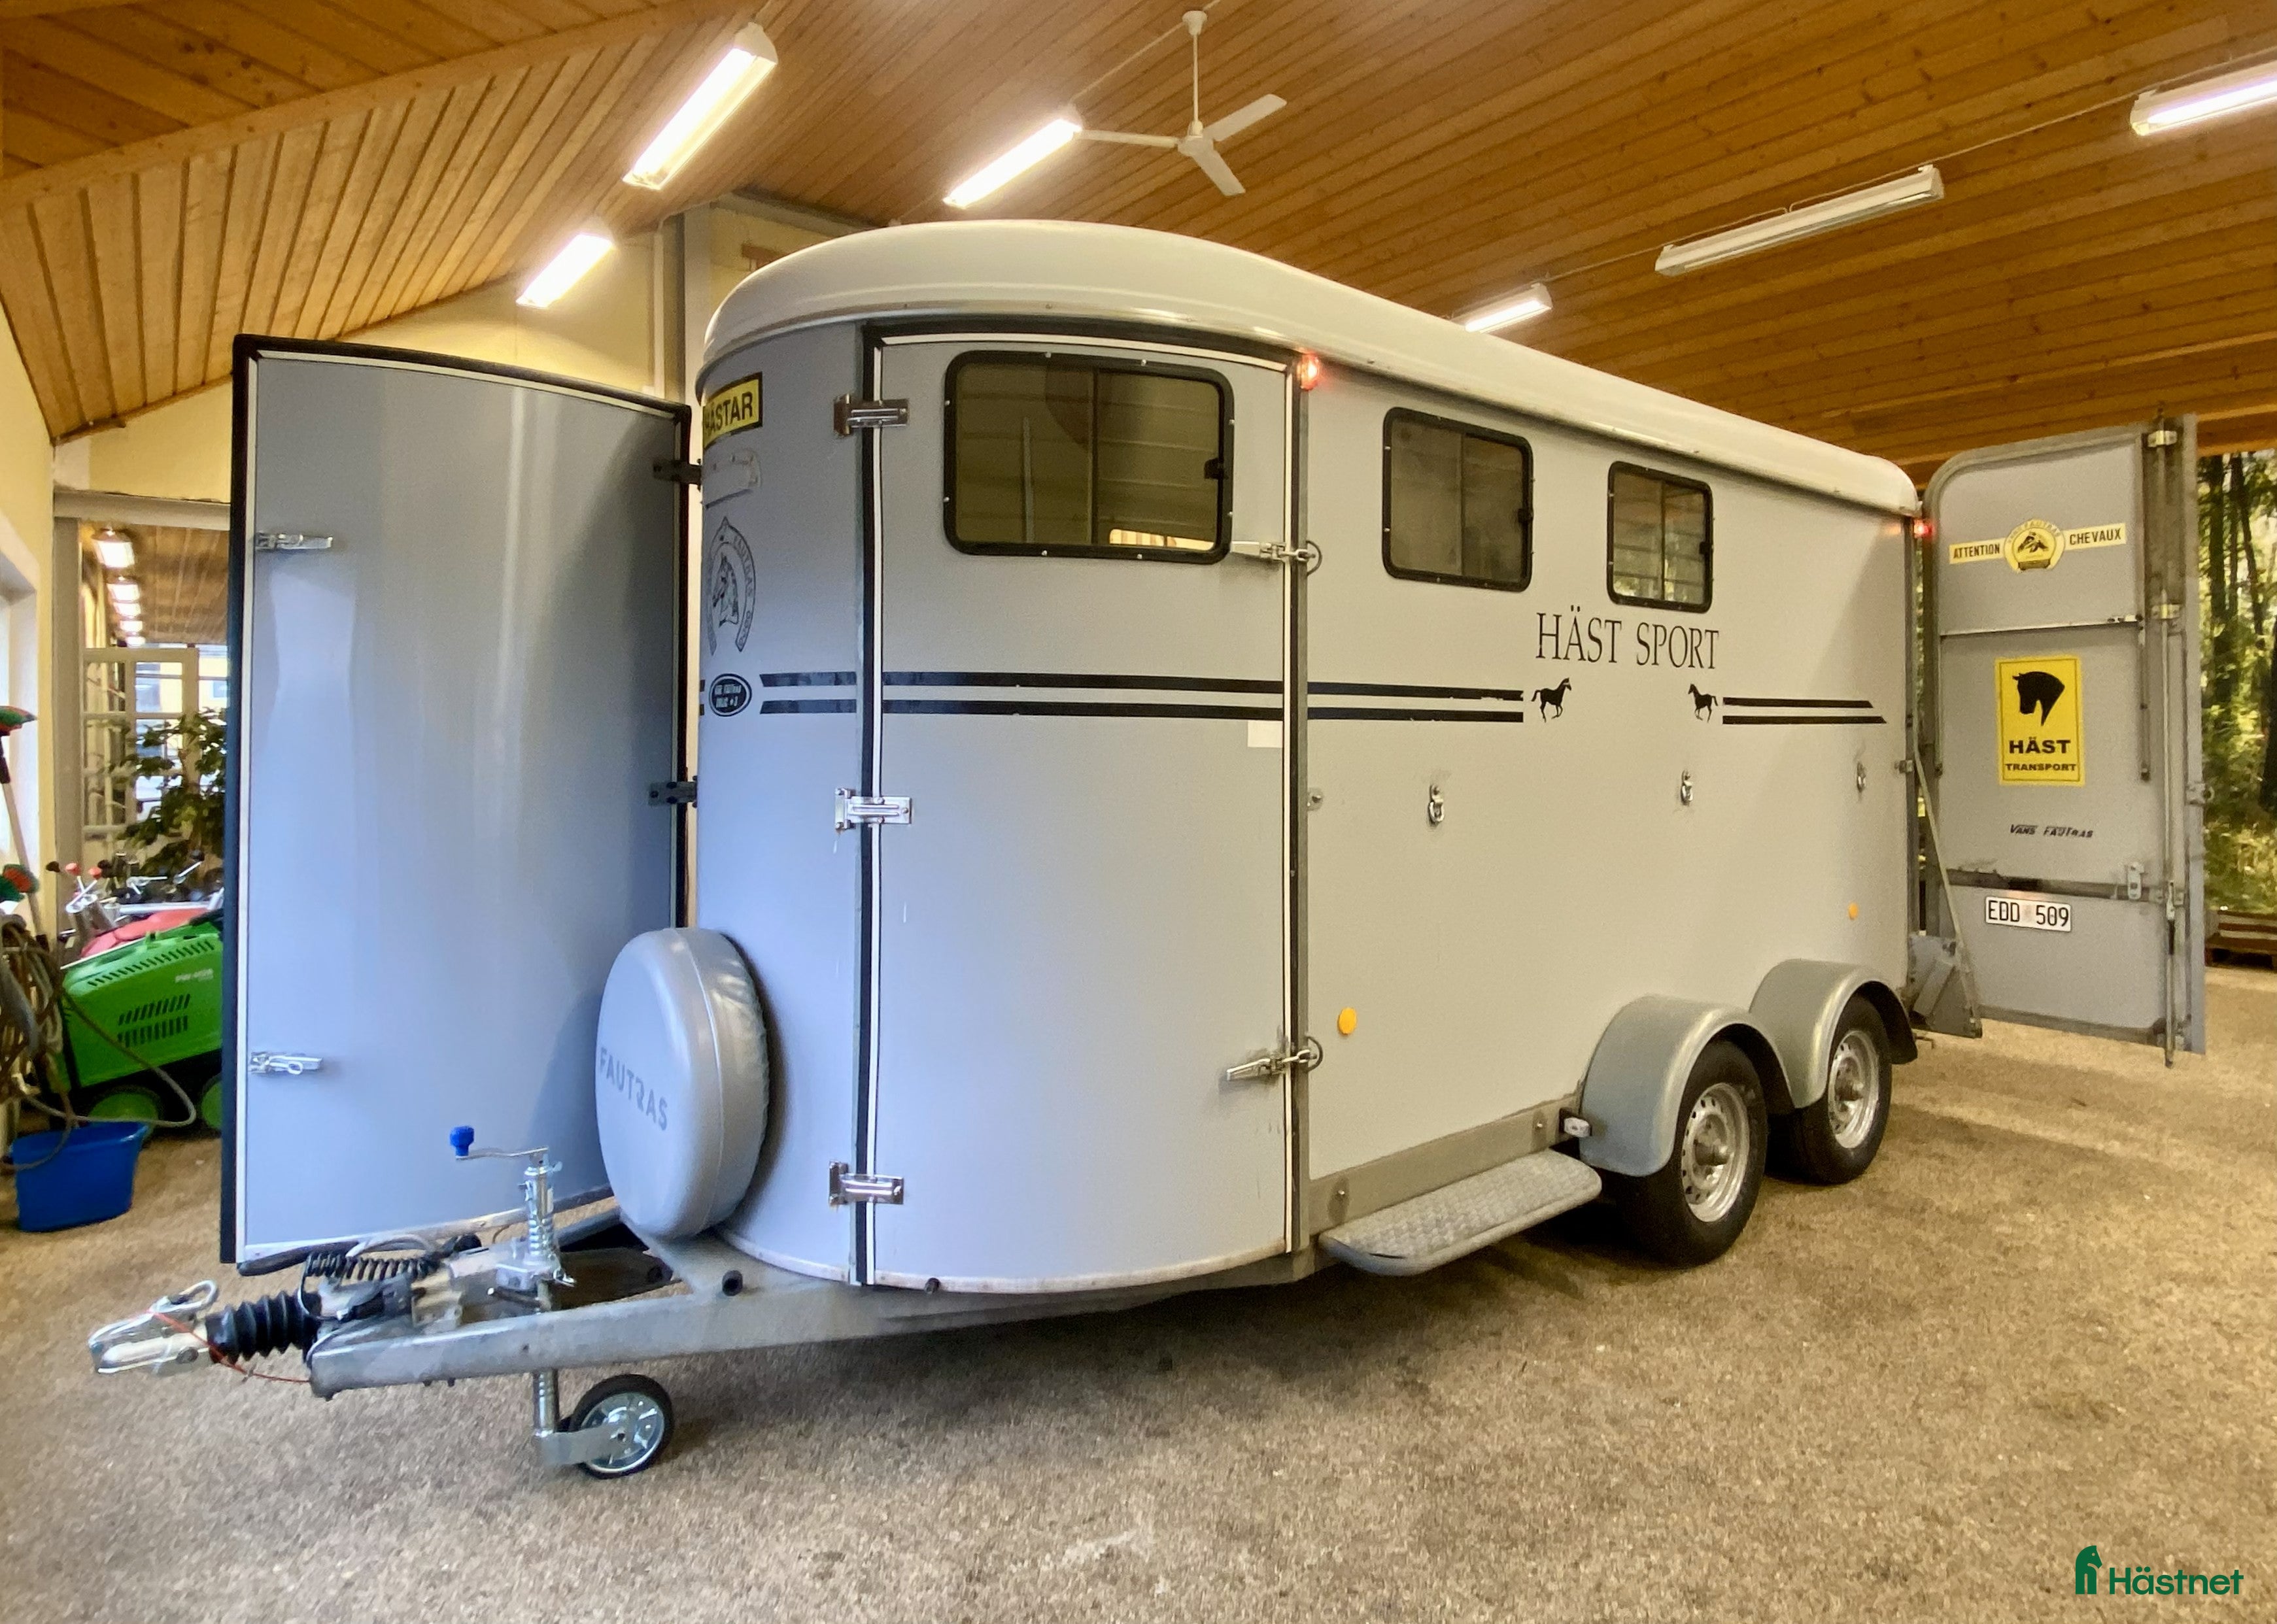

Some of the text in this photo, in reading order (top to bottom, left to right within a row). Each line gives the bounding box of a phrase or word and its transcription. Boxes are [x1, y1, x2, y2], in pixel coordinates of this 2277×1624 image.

[1953, 528, 2121, 559] ATTENTION CHEVAUX
[1535, 604, 1719, 669] HÄST SPORT
[2009, 736, 2071, 754] HÄST
[2005, 763, 2077, 771] TRANSPORT
[2010, 824, 2094, 838] VANS FAUTRAS
[1988, 900, 2070, 927] EDD 509
[600, 1046, 668, 1131] FAUTRAS
